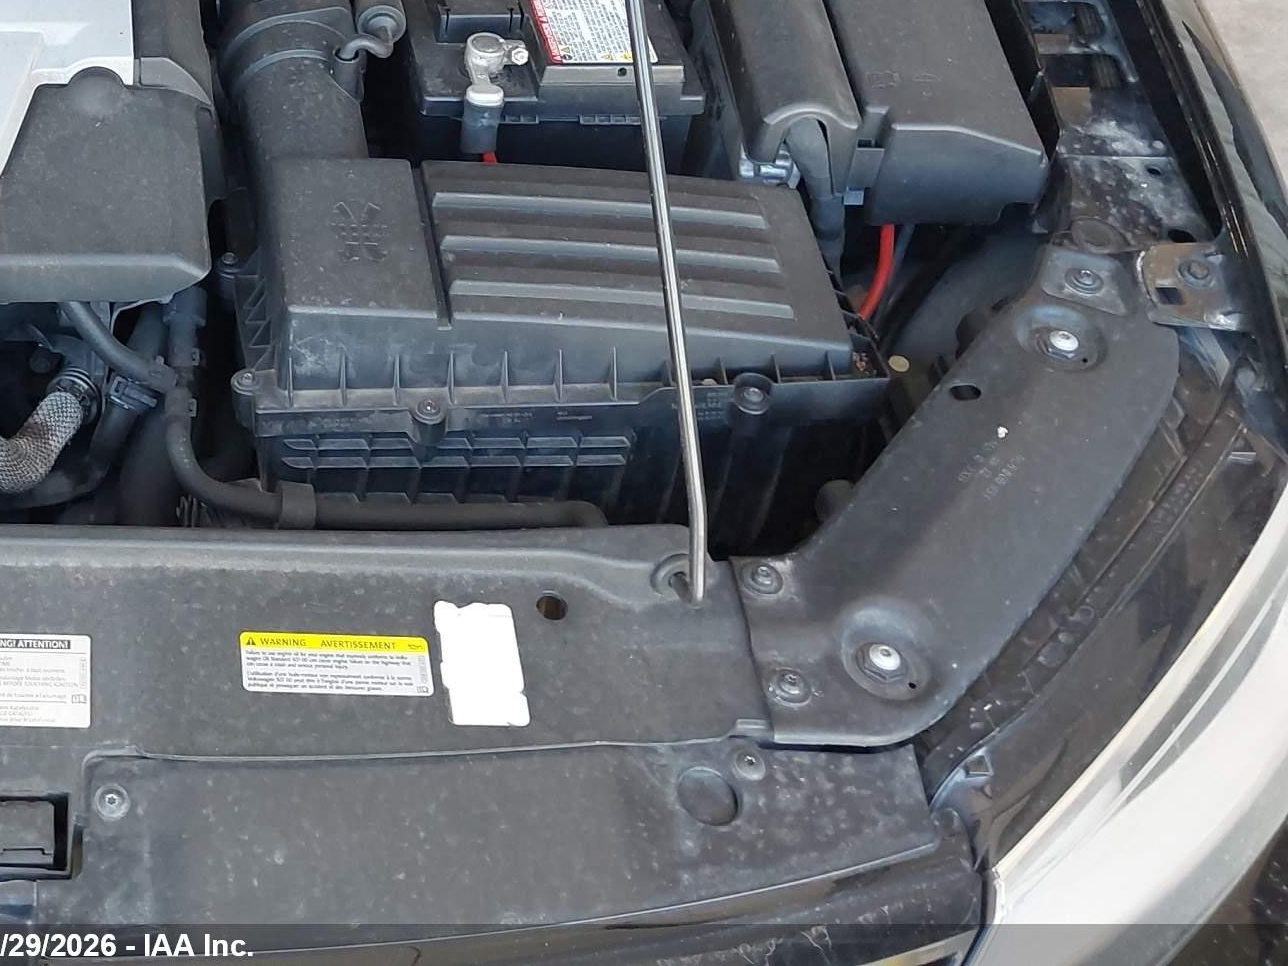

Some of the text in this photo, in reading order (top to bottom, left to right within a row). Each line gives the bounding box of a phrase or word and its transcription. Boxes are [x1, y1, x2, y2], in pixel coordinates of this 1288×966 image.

[17, 639, 69, 649] ATTENTION!
[259, 637, 396, 650] WARNING AVERTISSEMENT
